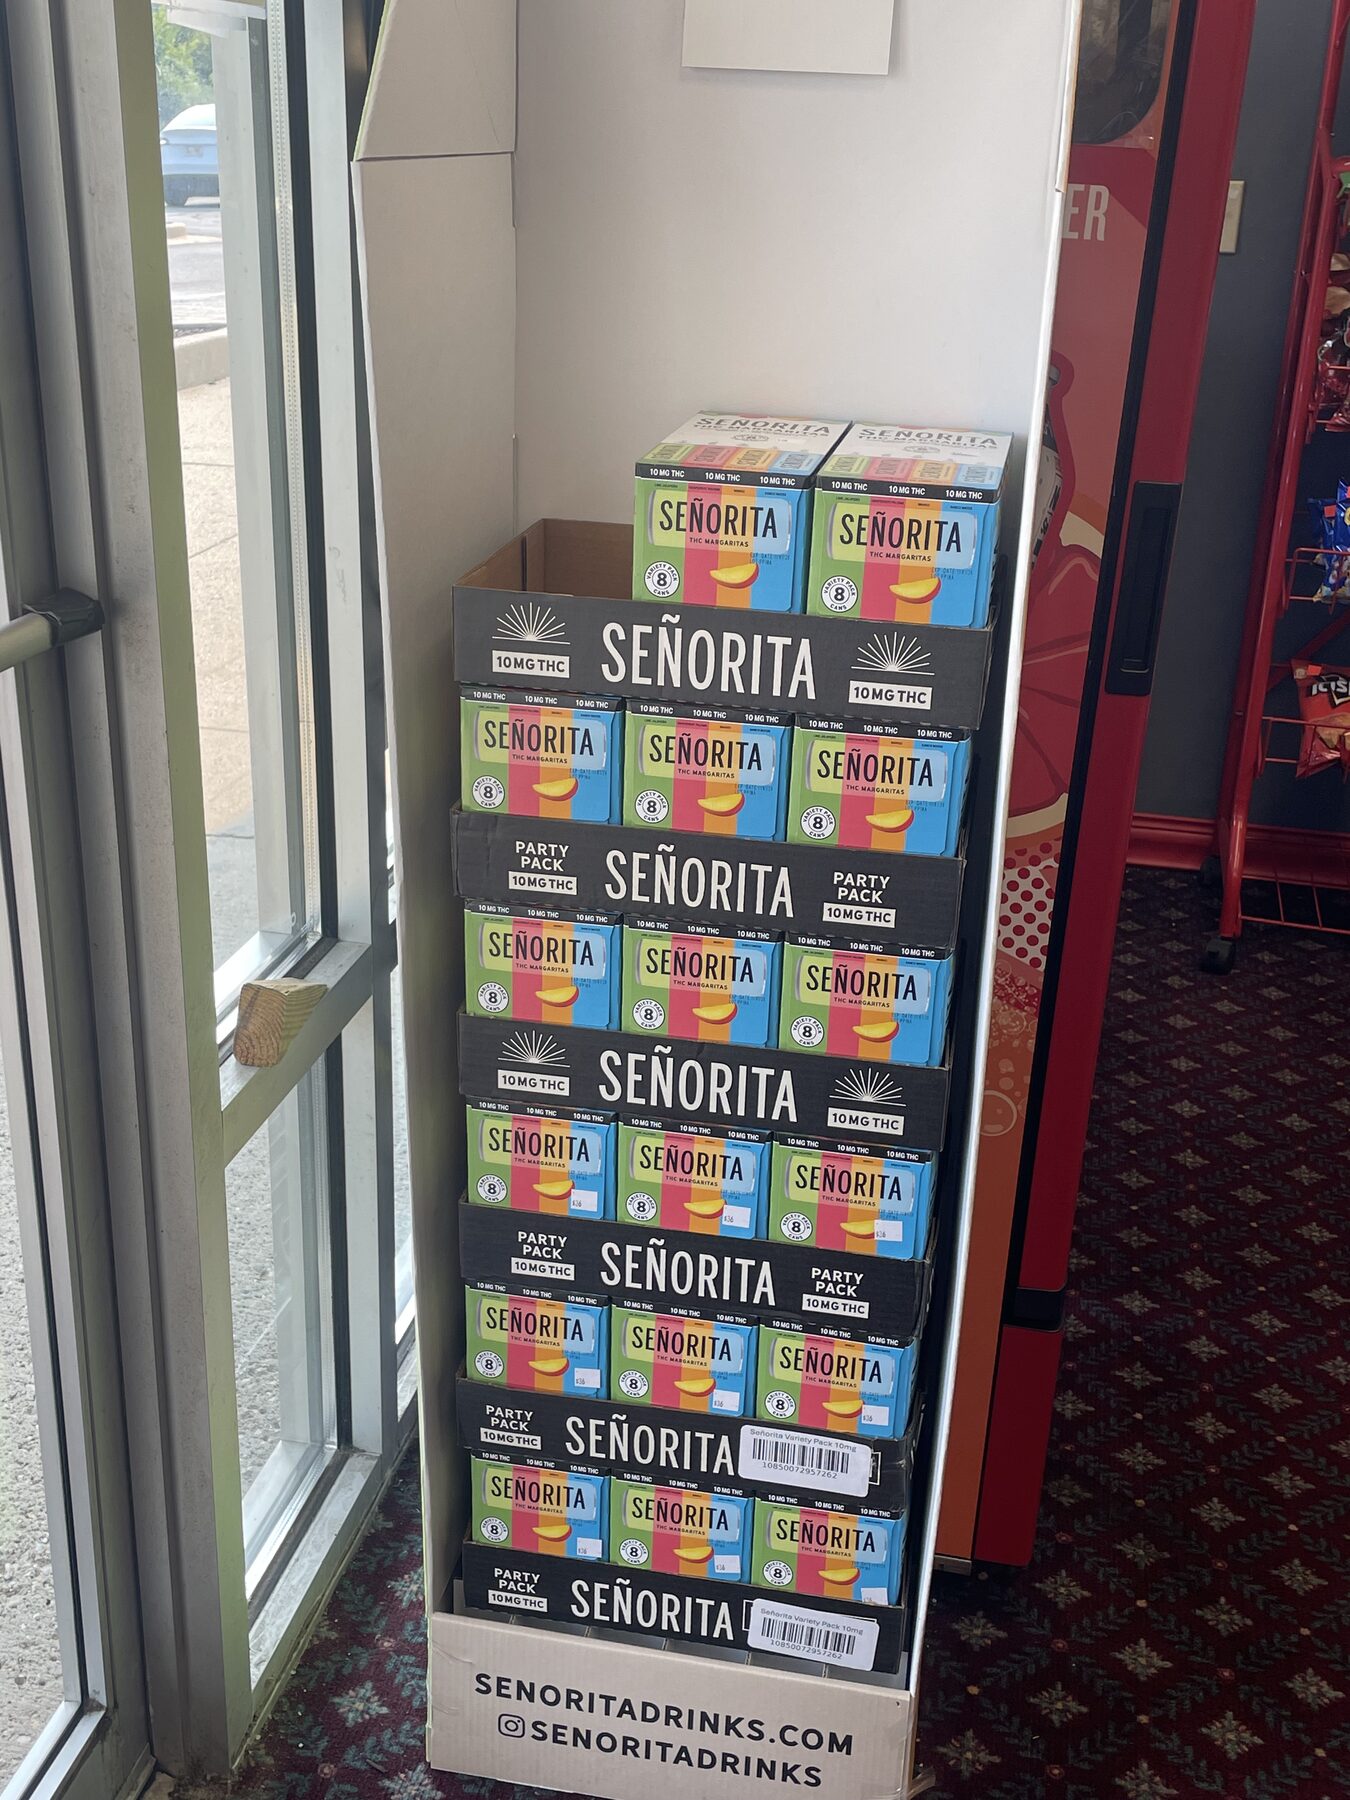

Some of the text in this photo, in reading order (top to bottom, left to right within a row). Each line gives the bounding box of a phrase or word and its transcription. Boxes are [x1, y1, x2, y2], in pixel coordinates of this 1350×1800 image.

[760, 476, 768, 484] 10
[854, 483, 867, 491] THC
[911, 487, 925, 495] THC
[660, 497, 777, 538] SEÑORITA
[840, 512, 961, 552] SEÑORITA
[646, 564, 666, 580] VARIETY
[657, 572, 668, 587] 8
[824, 578, 844, 594] VARIETY
[834, 586, 845, 602] 8
[602, 614, 815, 699] SEÑORITA
[537, 659, 565, 672] THC
[897, 690, 926, 704] THC
[484, 717, 594, 756] SEÑORITA
[650, 732, 762, 771] SEÑORITA
[817, 749, 933, 787] SEÑORITA
[483, 785, 493, 799] 8
[647, 800, 657, 814] 8
[812, 816, 823, 830] 8
[516, 841, 569, 857] PARTY
[521, 856, 563, 871] PACK
[549, 879, 573, 890] THC
[605, 844, 793, 917] SEÑORITA
[834, 872, 890, 889] PARTY
[838, 887, 882, 903] PACK
[865, 911, 891, 923] THC
[489, 930, 594, 966] SEÑORITA
[646, 947, 754, 983] SEÑORITA
[806, 964, 917, 1001] SEÑORITA
[488, 991, 498, 1004] 8
[644, 1008, 654, 1020] 8
[802, 1026, 813, 1038] 8
[540, 1079, 565, 1091] THC
[599, 1045, 797, 1122] SEÑORITA
[872, 1118, 899, 1130] THC
[489, 1127, 590, 1162] SEÑORITA
[640, 1144, 743, 1181] SEÑORITA
[487, 1183, 497, 1195] 8
[795, 1165, 901, 1201] SEÑORITA
[637, 1201, 646, 1213] 8
[791, 1221, 801, 1233] 8
[518, 1231, 567, 1247] PARTY
[523, 1244, 562, 1259] PACK
[548, 1266, 570, 1276] THC
[601, 1238, 775, 1306] SEÑORITA
[812, 1268, 863, 1284] PARTY
[816, 1281, 857, 1297] PACK
[841, 1303, 864, 1314] THC
[486, 1306, 584, 1341] SEÑORITA
[632, 1324, 732, 1362] SEÑORITA
[485, 1359, 494, 1370] 8
[780, 1345, 882, 1383] SEÑORITA
[629, 1378, 639, 1389] 8
[776, 1399, 785, 1410] 8
[486, 1405, 533, 1421] PARTY
[491, 1417, 529, 1431] PACK
[516, 1436, 537, 1446] THC
[566, 1414, 734, 1475] SEÑORITA
[785, 1434, 813, 1444] Variety
[813, 1439, 832, 1447] Pack
[835, 1442, 857, 1452] 10mg
[491, 1475, 586, 1509] SEÑORITA
[632, 1496, 728, 1531] SEÑORITA
[490, 1524, 499, 1535] 8
[776, 1519, 875, 1552] SEÑORITA
[629, 1546, 639, 1557] 8
[495, 1568, 540, 1583] PARTY
[773, 1568, 782, 1578] 8
[499, 1579, 535, 1594] PACK
[523, 1598, 543, 1608] THC
[571, 1578, 733, 1640] SEÑORITA
[794, 1616, 820, 1626] Variety
[821, 1621, 840, 1630] Pack
[475, 1673, 852, 1755] SENORITADRINKS.COM
[531, 1721, 821, 1787] SENORITADRINKS
